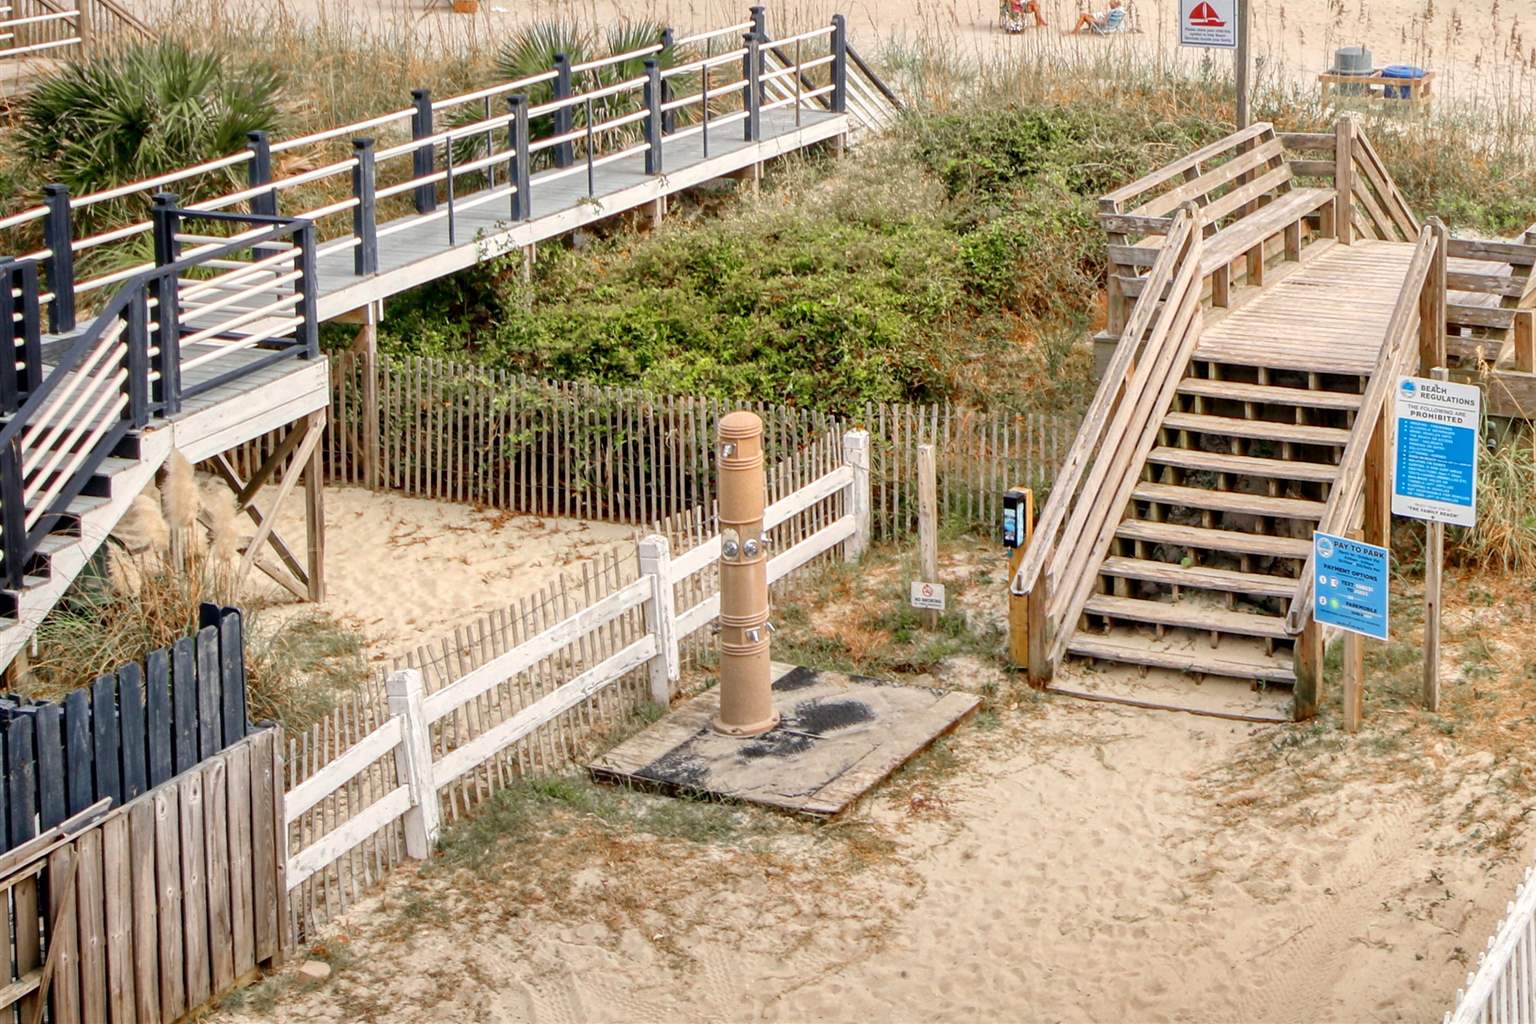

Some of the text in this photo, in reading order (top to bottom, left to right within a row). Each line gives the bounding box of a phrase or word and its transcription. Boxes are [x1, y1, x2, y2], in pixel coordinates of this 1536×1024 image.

[1421, 385, 1447, 394] BEACH
[1421, 393, 1475, 406] REGULATIONS
[1410, 410, 1463, 424] PROHIBITED
[1420, 406, 1453, 415] FOLLOWING
[1333, 541, 1349, 550] PAY
[1351, 545, 1362, 553] TO
[1364, 548, 1385, 558] PARK
[1323, 563, 1351, 575] PAYMENT
[1351, 571, 1378, 582] OPTIONS
